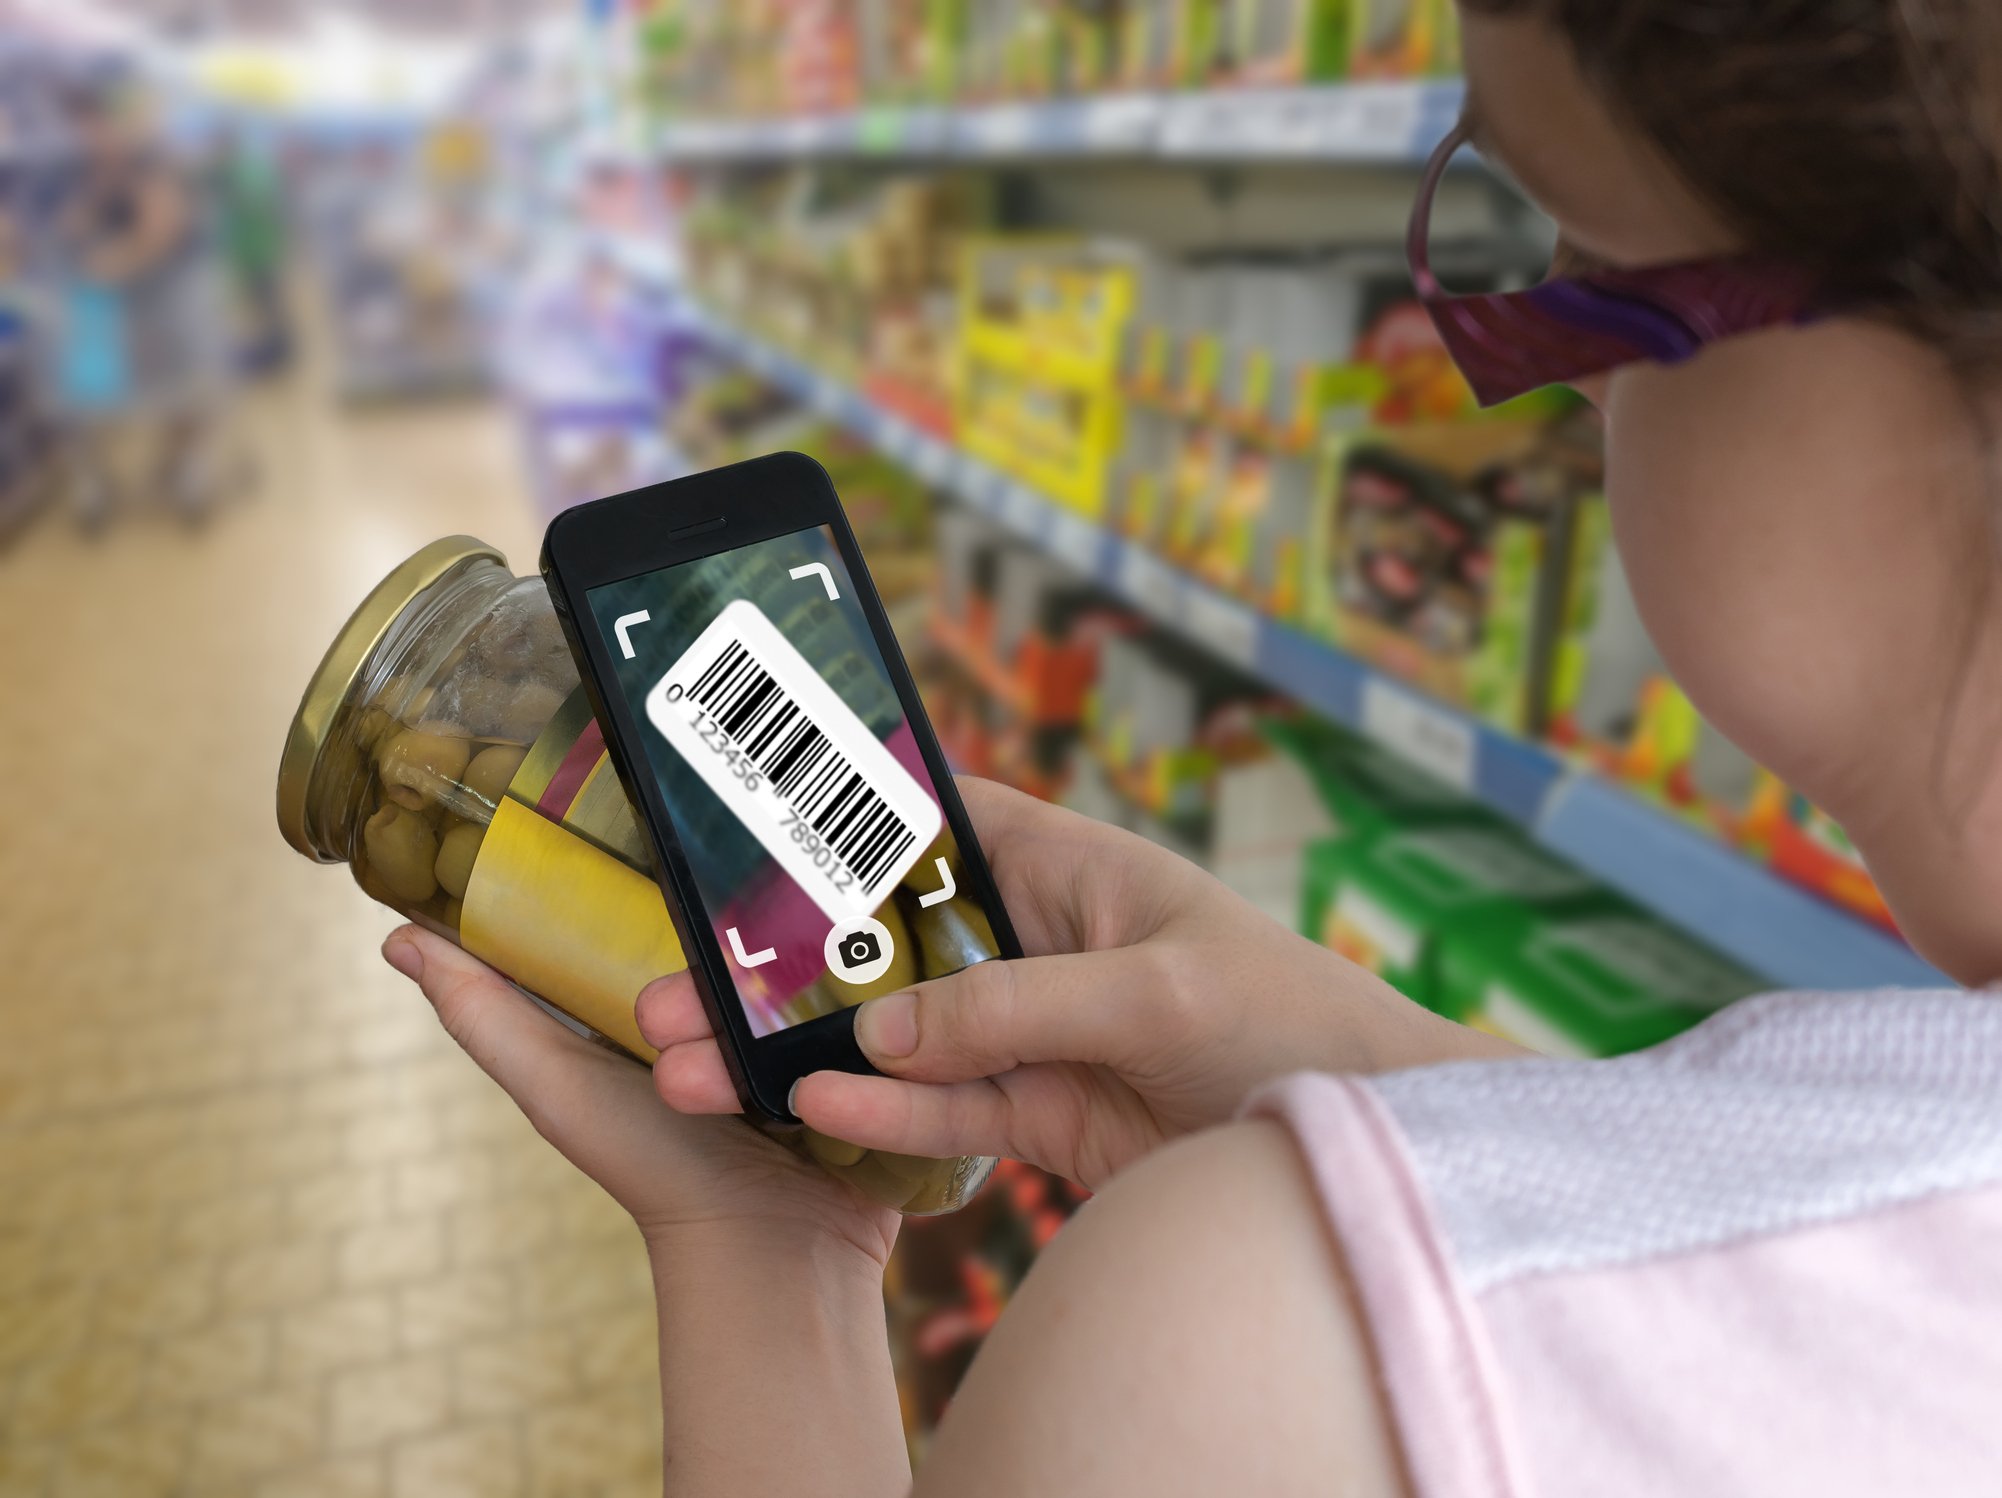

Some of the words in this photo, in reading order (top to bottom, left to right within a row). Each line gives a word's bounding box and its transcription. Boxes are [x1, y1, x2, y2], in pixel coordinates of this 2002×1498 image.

[665, 683, 684, 703] 0
[689, 710, 764, 792] 123456
[779, 806, 854, 894] 789012
